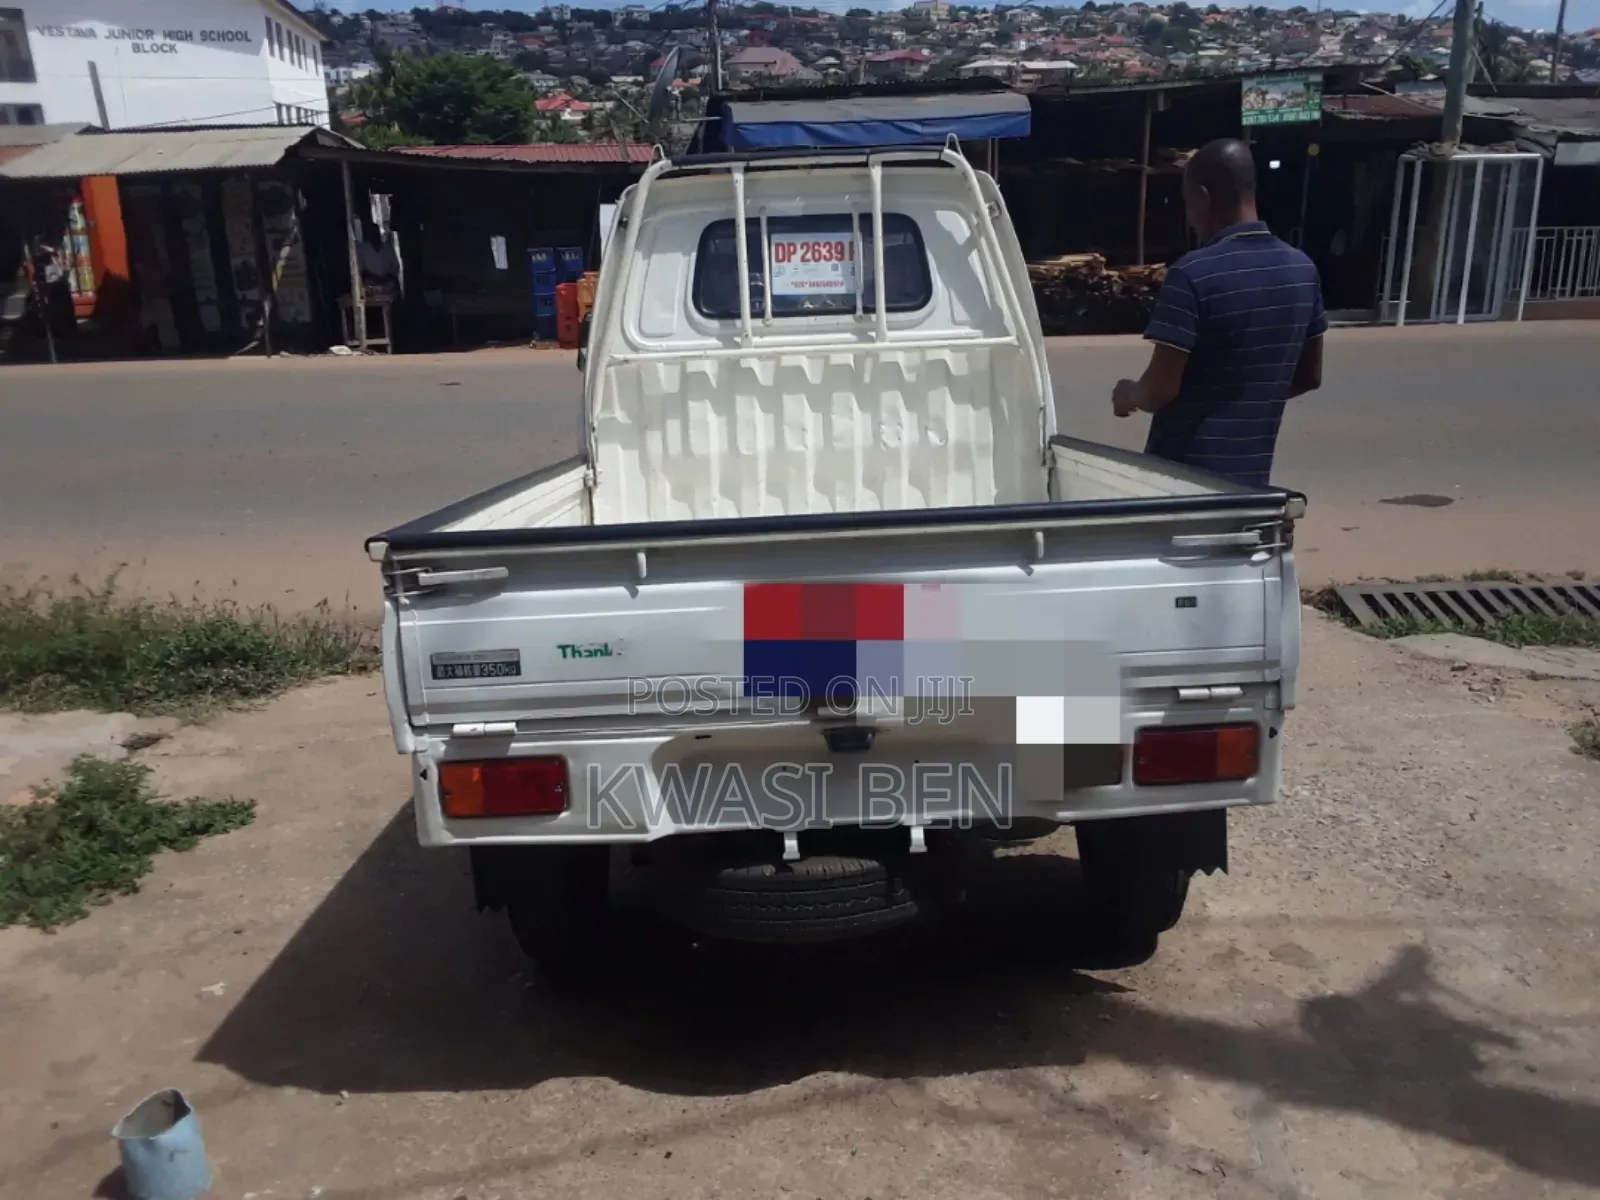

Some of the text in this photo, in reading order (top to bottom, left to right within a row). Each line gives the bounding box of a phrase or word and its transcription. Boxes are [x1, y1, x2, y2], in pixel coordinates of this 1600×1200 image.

[104, 27, 155, 41] JUNIOR
[163, 29, 193, 41] HIGH
[200, 29, 252, 43] SCHOOL
[131, 42, 179, 54] BLOCK
[774, 242, 797, 263] DP
[800, 241, 845, 263] 2639
